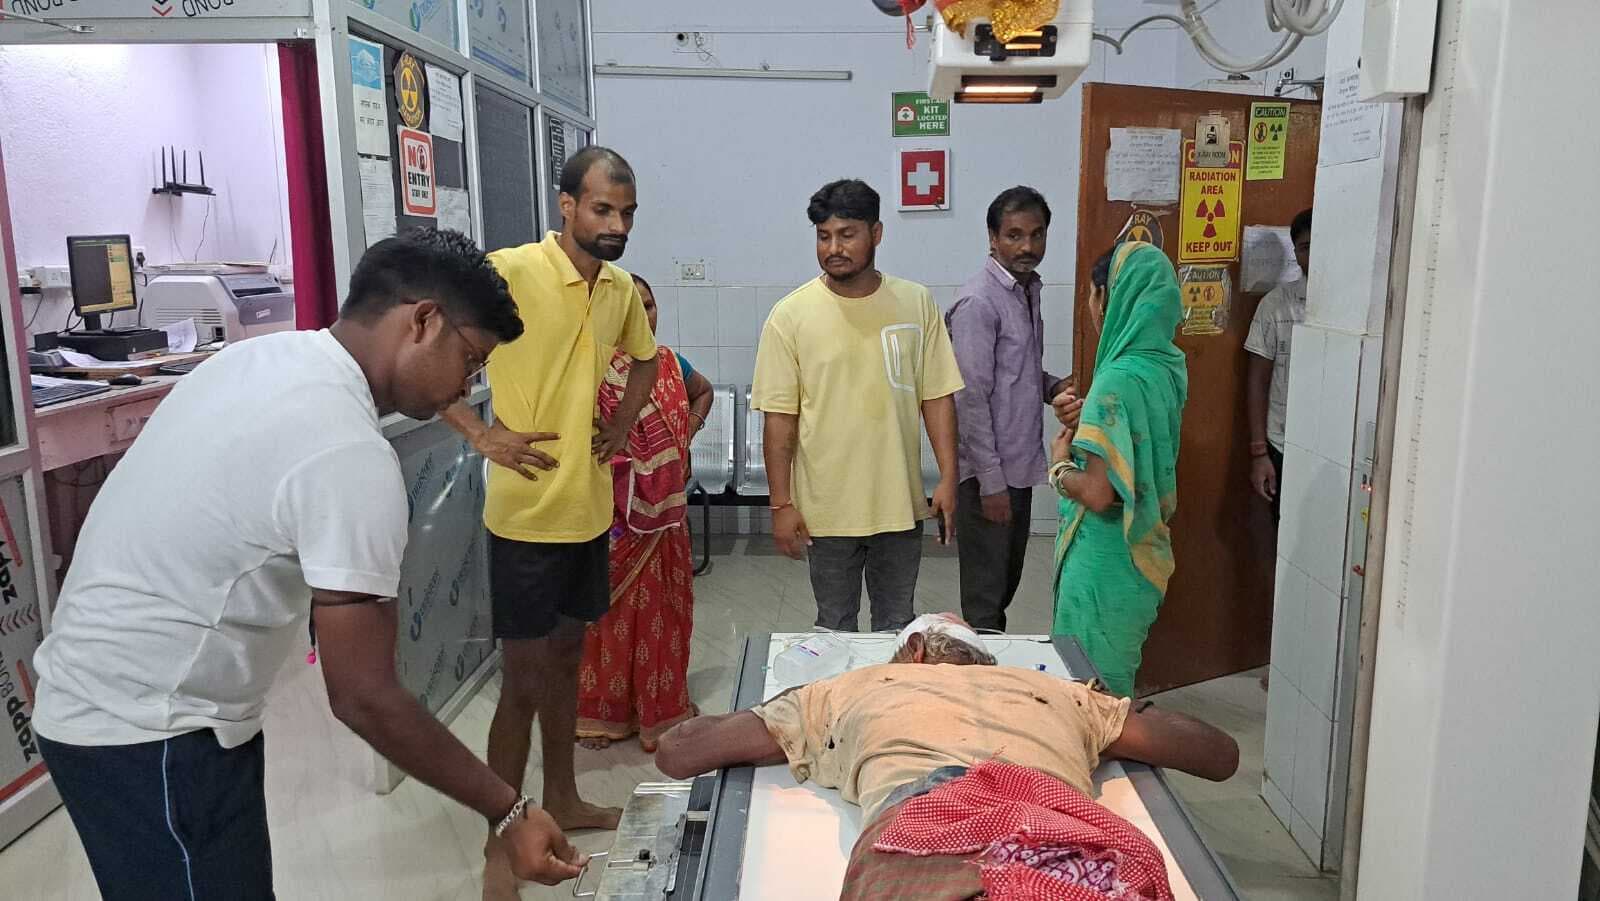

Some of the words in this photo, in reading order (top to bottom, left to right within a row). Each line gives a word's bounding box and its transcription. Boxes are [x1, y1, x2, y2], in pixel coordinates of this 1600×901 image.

[923, 105, 939, 114] KIT
[1255, 107, 1286, 117] CAUTION
[919, 121, 945, 130] HERE
[408, 171, 430, 188] ENTRY
[1189, 171, 1236, 181] RADIATION
[1200, 185, 1224, 195] AREA
[1185, 241, 1210, 252] KEEP
[1213, 240, 1233, 251] OUT
